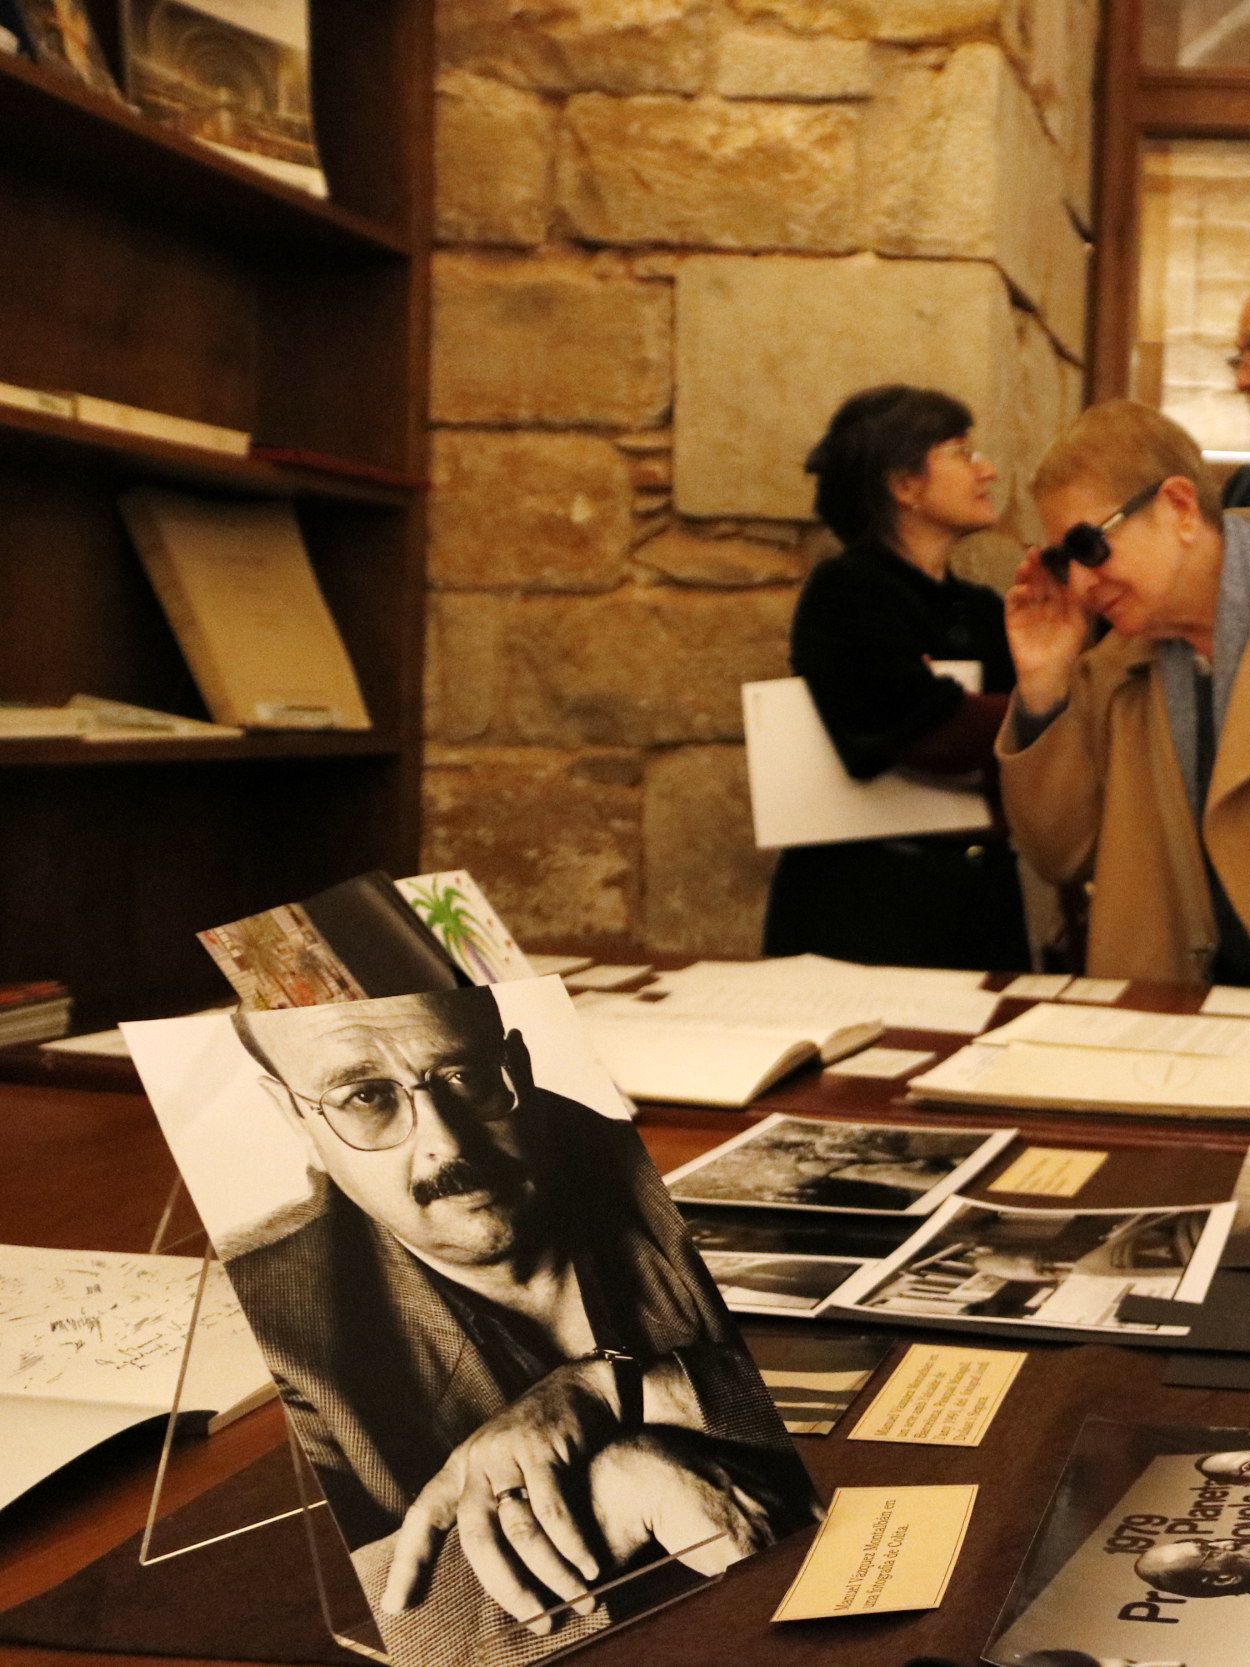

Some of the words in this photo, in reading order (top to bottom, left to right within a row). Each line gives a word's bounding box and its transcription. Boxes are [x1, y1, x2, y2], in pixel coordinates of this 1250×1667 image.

[883, 1549, 900, 1559] de
[1102, 1512, 1169, 1554] 1979
[834, 1584, 861, 1610] Manuel
[863, 1511, 892, 1551] Montalbán
[884, 1499, 896, 1510] en
